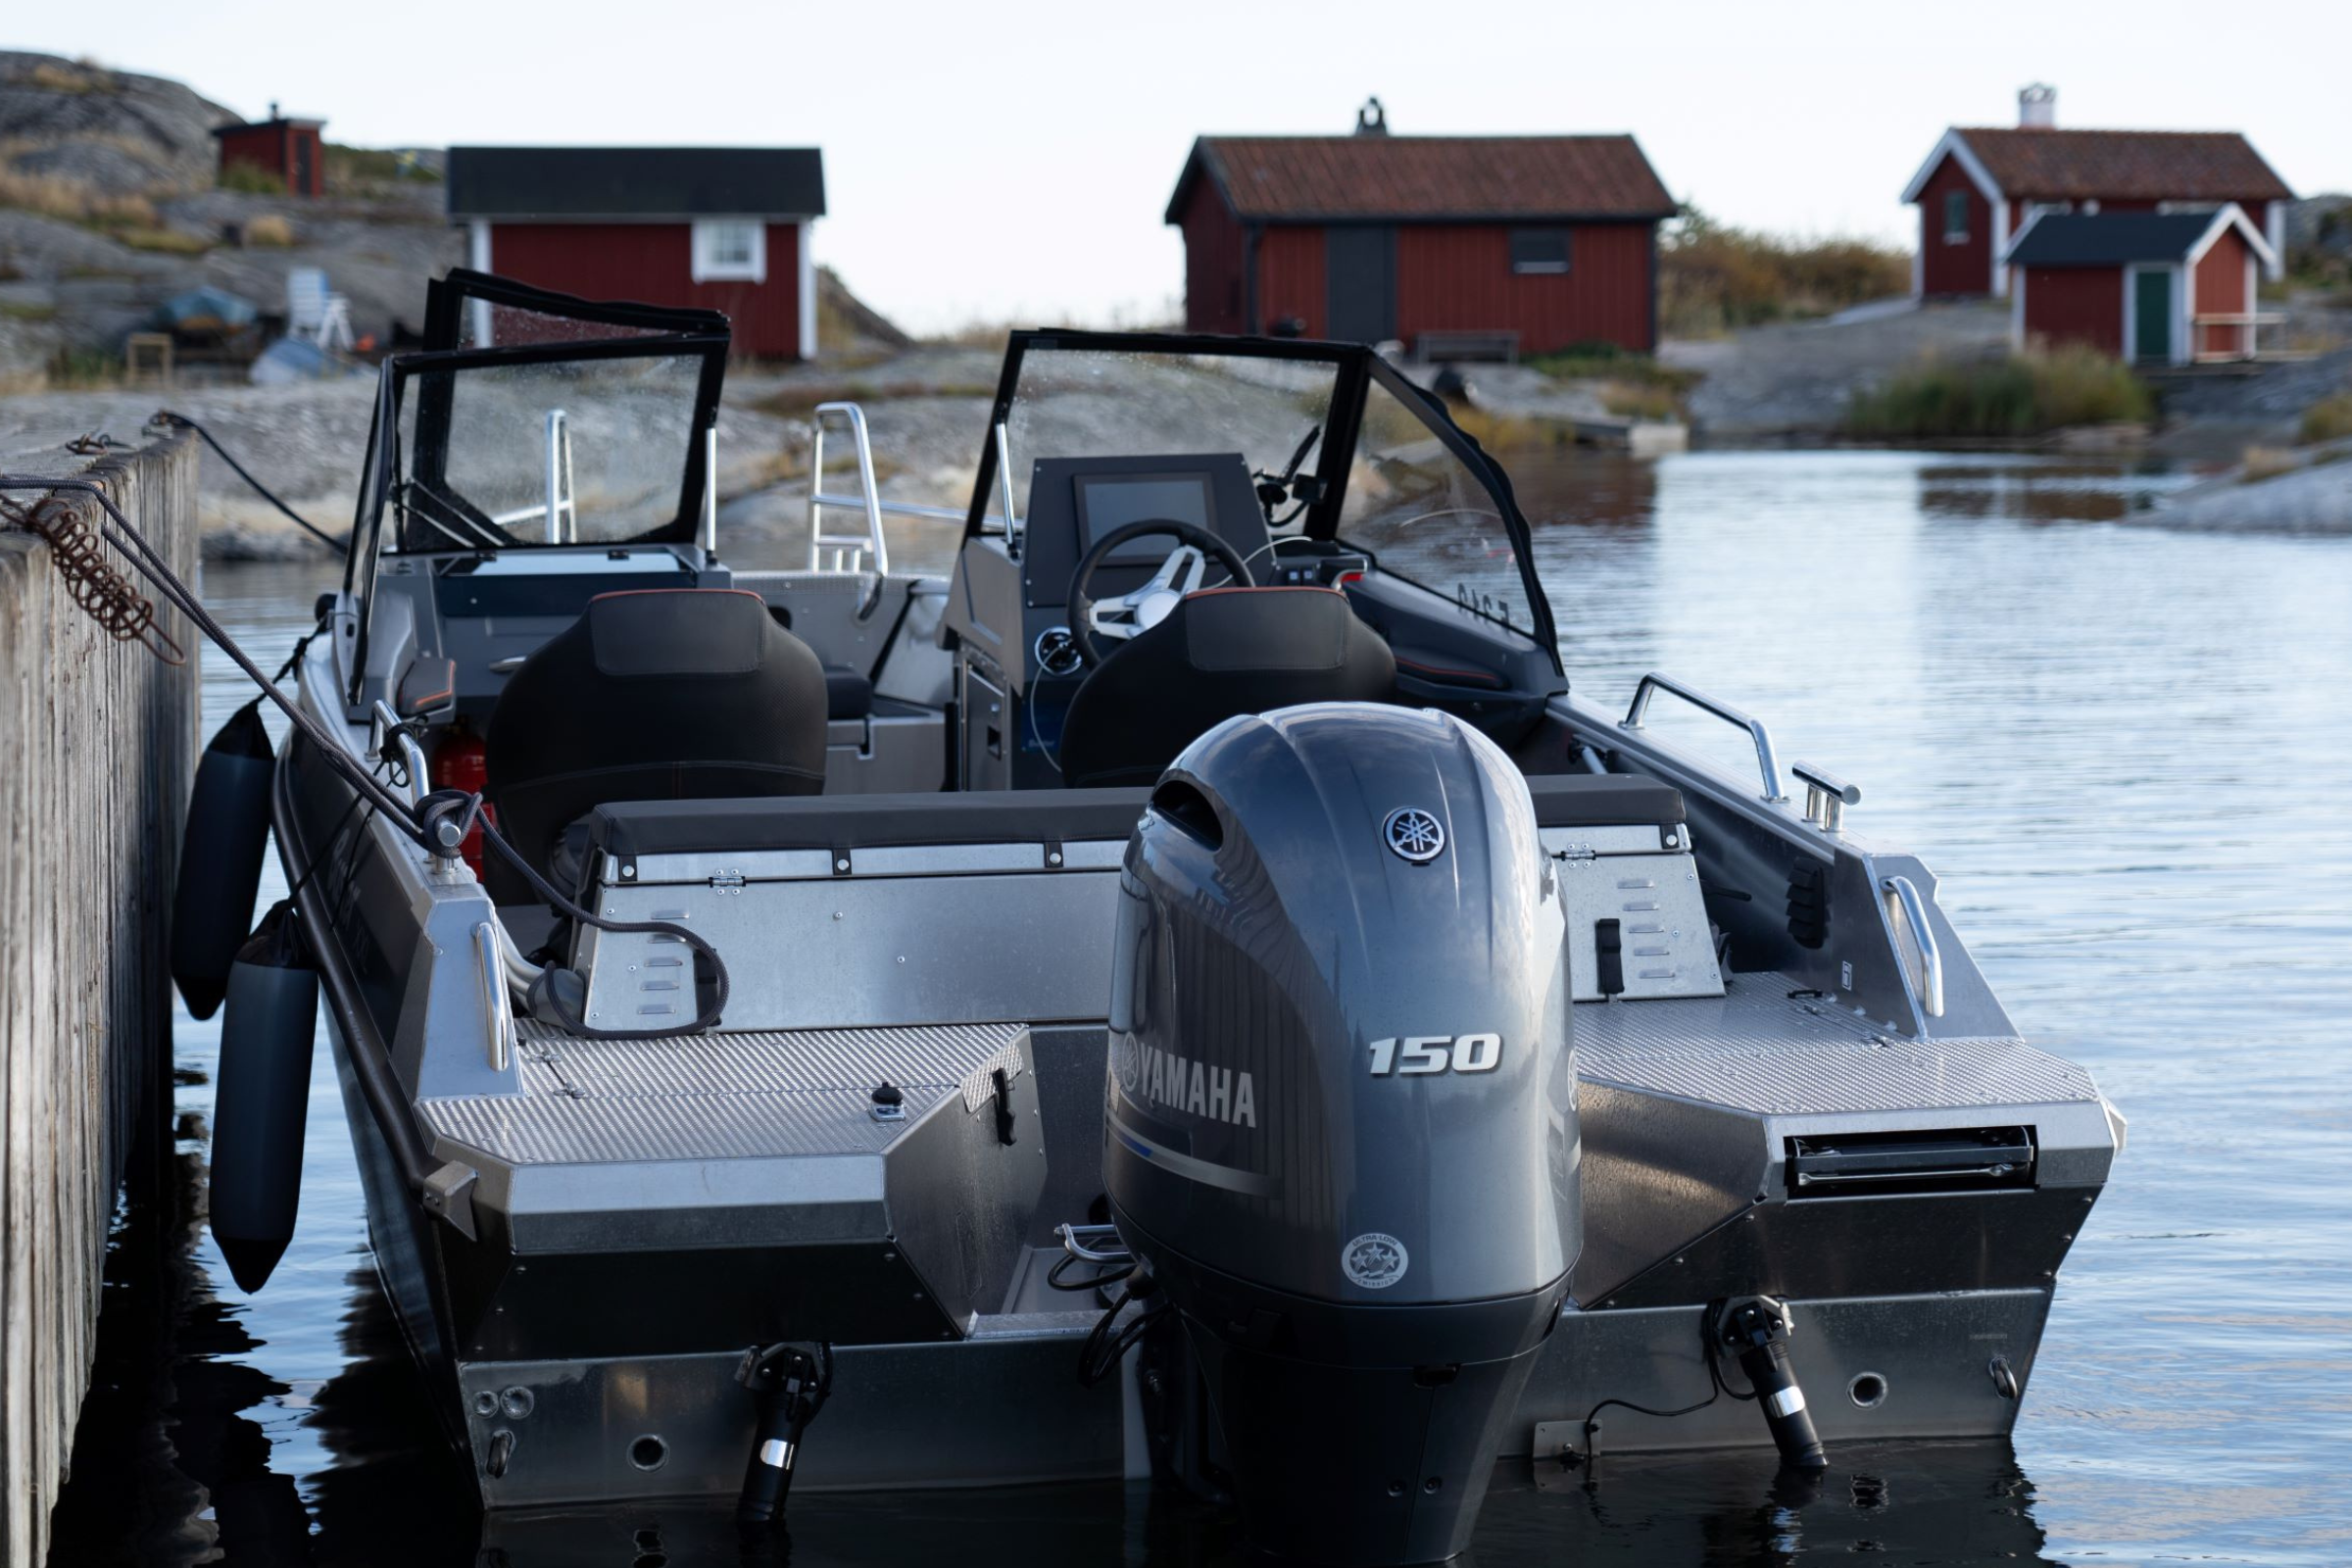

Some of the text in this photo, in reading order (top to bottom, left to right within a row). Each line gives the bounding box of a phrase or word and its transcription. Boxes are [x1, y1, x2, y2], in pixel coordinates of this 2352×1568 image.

[1369, 1032, 1501, 1074] 150
[1140, 1042, 1257, 1129] YAMAHA
[1351, 1234, 1397, 1247] ULTRA LOW
